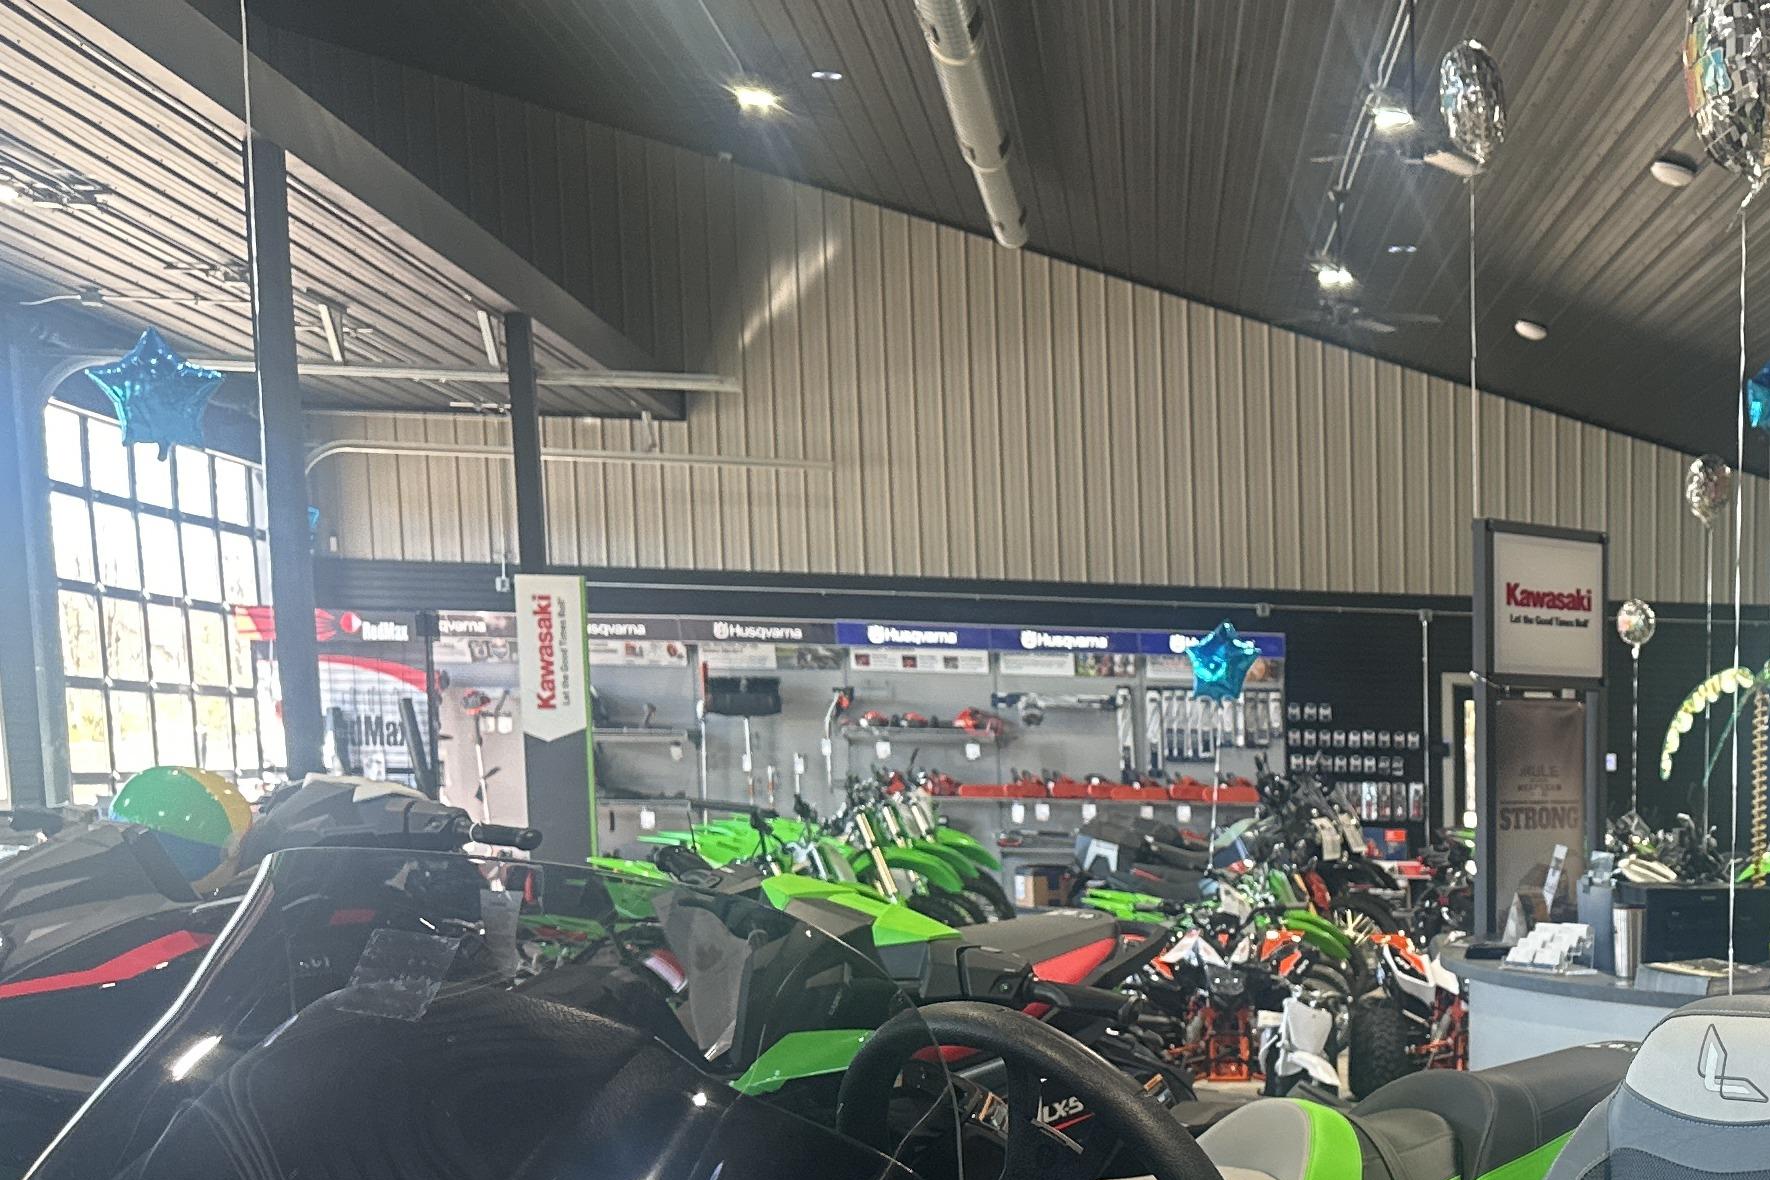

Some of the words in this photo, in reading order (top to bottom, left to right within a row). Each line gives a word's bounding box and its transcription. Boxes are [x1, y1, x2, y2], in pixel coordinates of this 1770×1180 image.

[1506, 582, 1592, 612] Kawasaki
[362, 621, 409, 641] RedMax
[729, 624, 803, 640] Husqvarna
[884, 627, 958, 644] Husqvarna
[1037, 632, 1108, 649] Husqvarna
[531, 594, 557, 710] Kawasaki
[1499, 806, 1579, 831] STRONG
